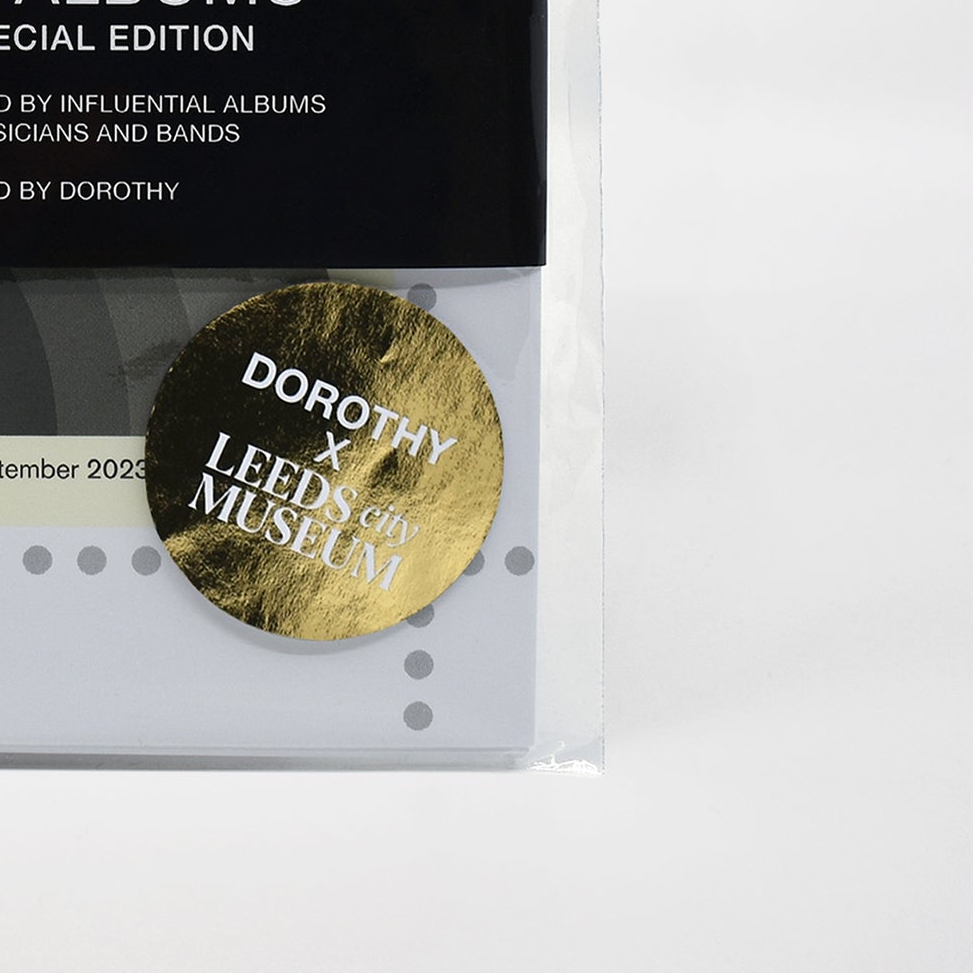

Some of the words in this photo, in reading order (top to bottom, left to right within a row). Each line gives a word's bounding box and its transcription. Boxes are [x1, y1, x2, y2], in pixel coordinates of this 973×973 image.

[109, 24, 254, 52] EDITION
[20, 94, 52, 113] BY
[61, 94, 216, 114] INFLUENTIAL
[222, 94, 326, 114] ALBUMS
[96, 123, 148, 143] AND
[157, 123, 240, 143] BANDS
[20, 181, 52, 200] BY
[60, 180, 180, 201] DOROTHY
[242, 351, 457, 466] DOROTHY
[314, 431, 351, 471] X
[87, 458, 145, 480] 2023
[205, 432, 358, 524] LEEDS
[360, 504, 419, 547] city
[188, 472, 403, 592] MUSEUM
